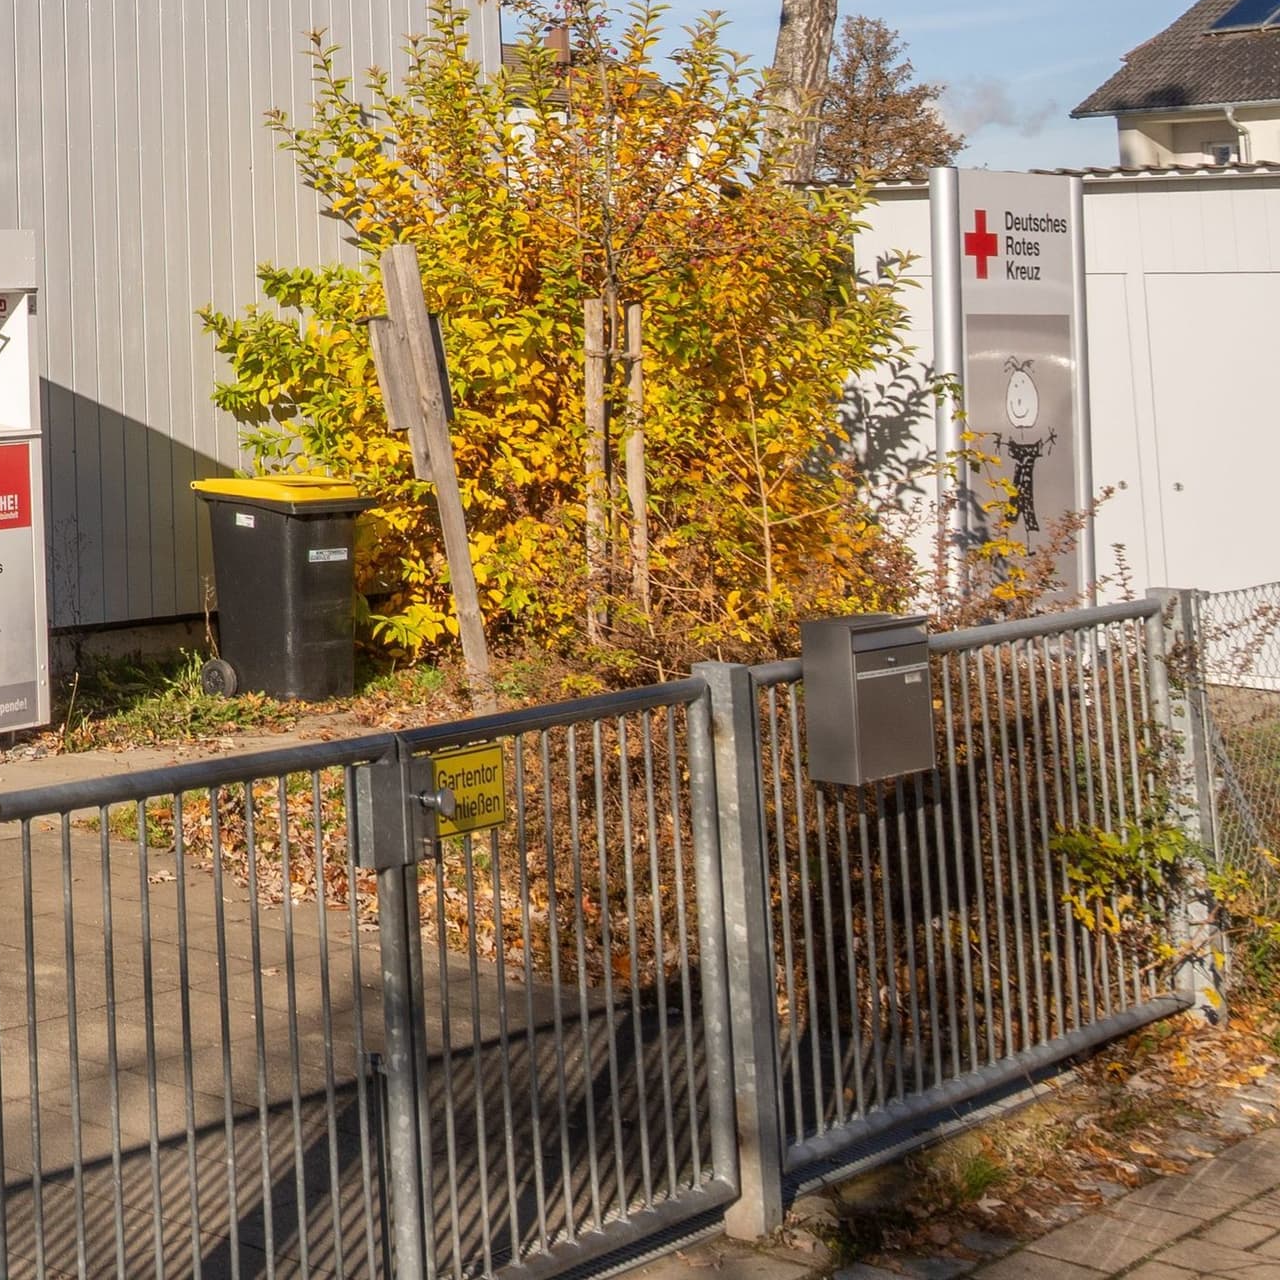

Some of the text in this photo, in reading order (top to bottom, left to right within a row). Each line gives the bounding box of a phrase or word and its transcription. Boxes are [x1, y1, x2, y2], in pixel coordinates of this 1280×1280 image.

[1005, 211, 1067, 233] Deutsches
[1006, 235, 1040, 256] Rotes
[1006, 260, 1040, 280] Kreuz
[438, 763, 498, 790] Gartentor
[440, 793, 500, 824] hließen
